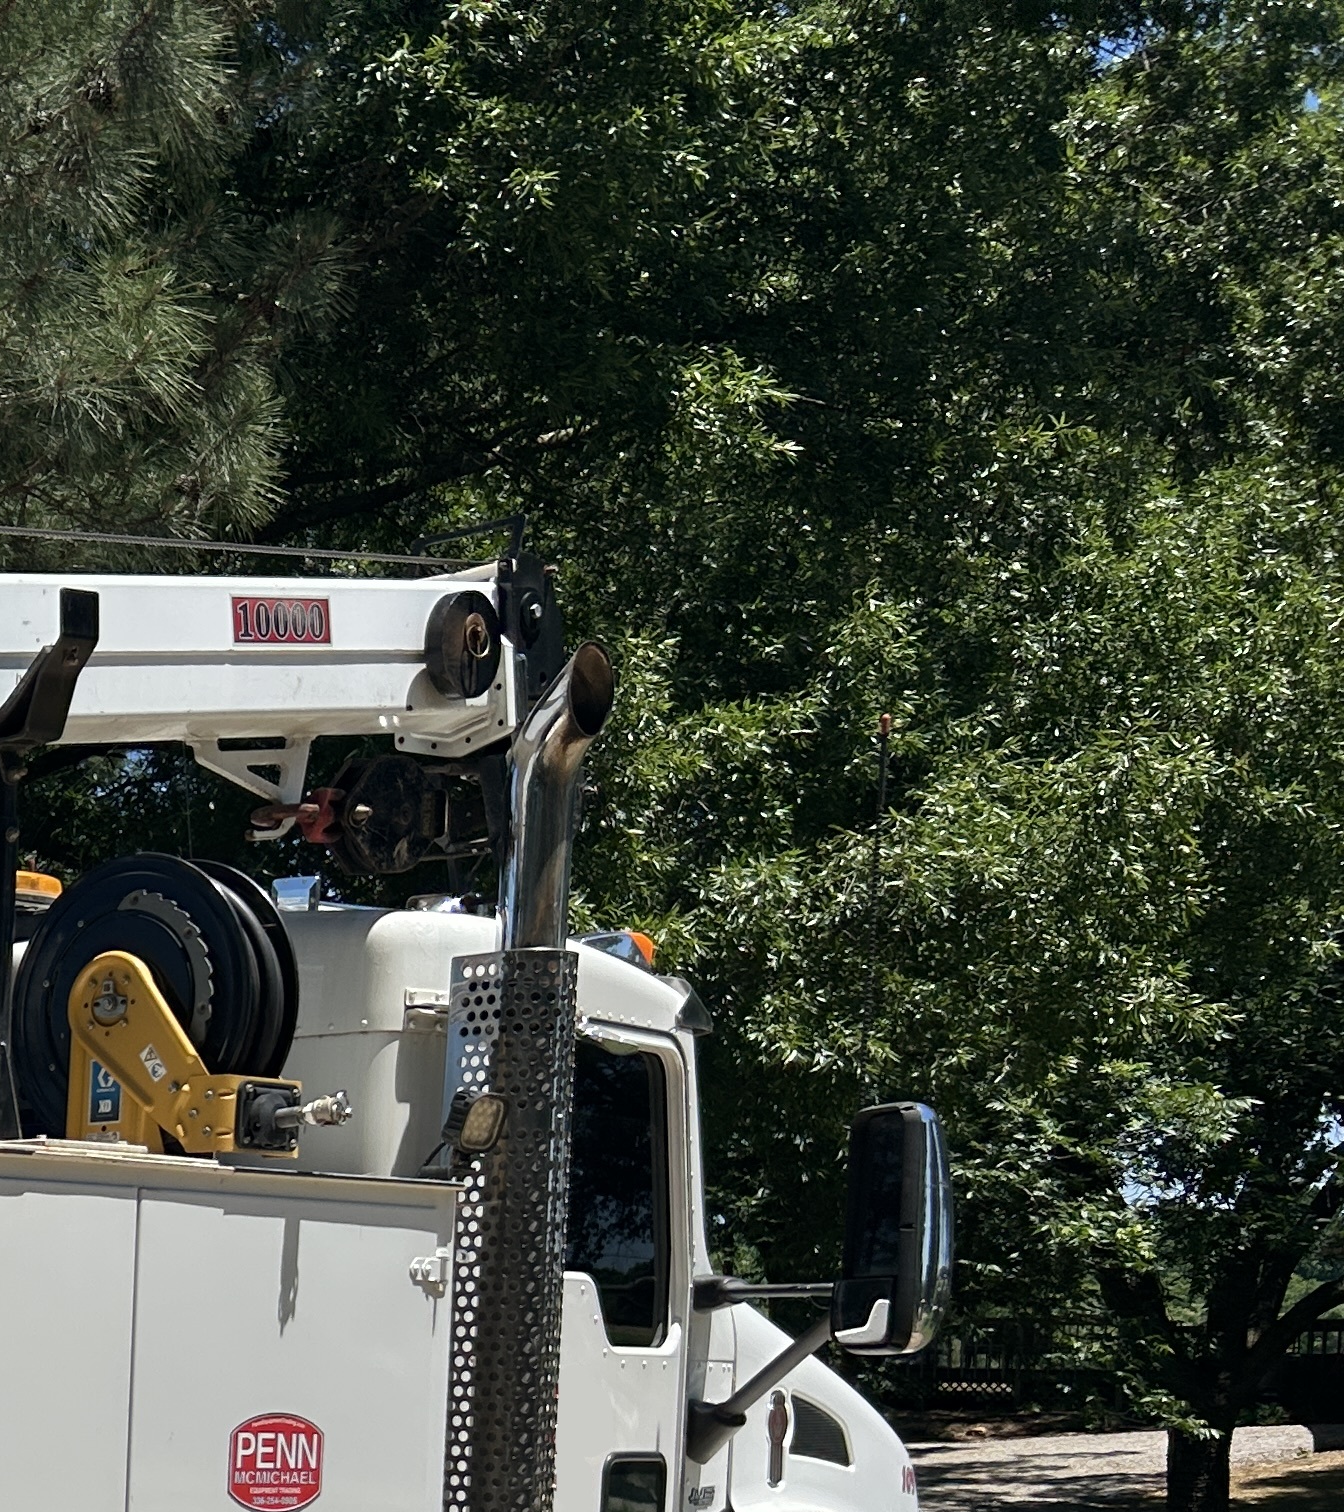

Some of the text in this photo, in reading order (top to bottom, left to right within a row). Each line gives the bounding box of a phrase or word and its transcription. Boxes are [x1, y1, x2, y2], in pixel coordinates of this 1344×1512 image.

[236, 599, 326, 640] 10000
[235, 1432, 318, 1469] PENN
[234, 1470, 317, 1485] MCMICHAEL
